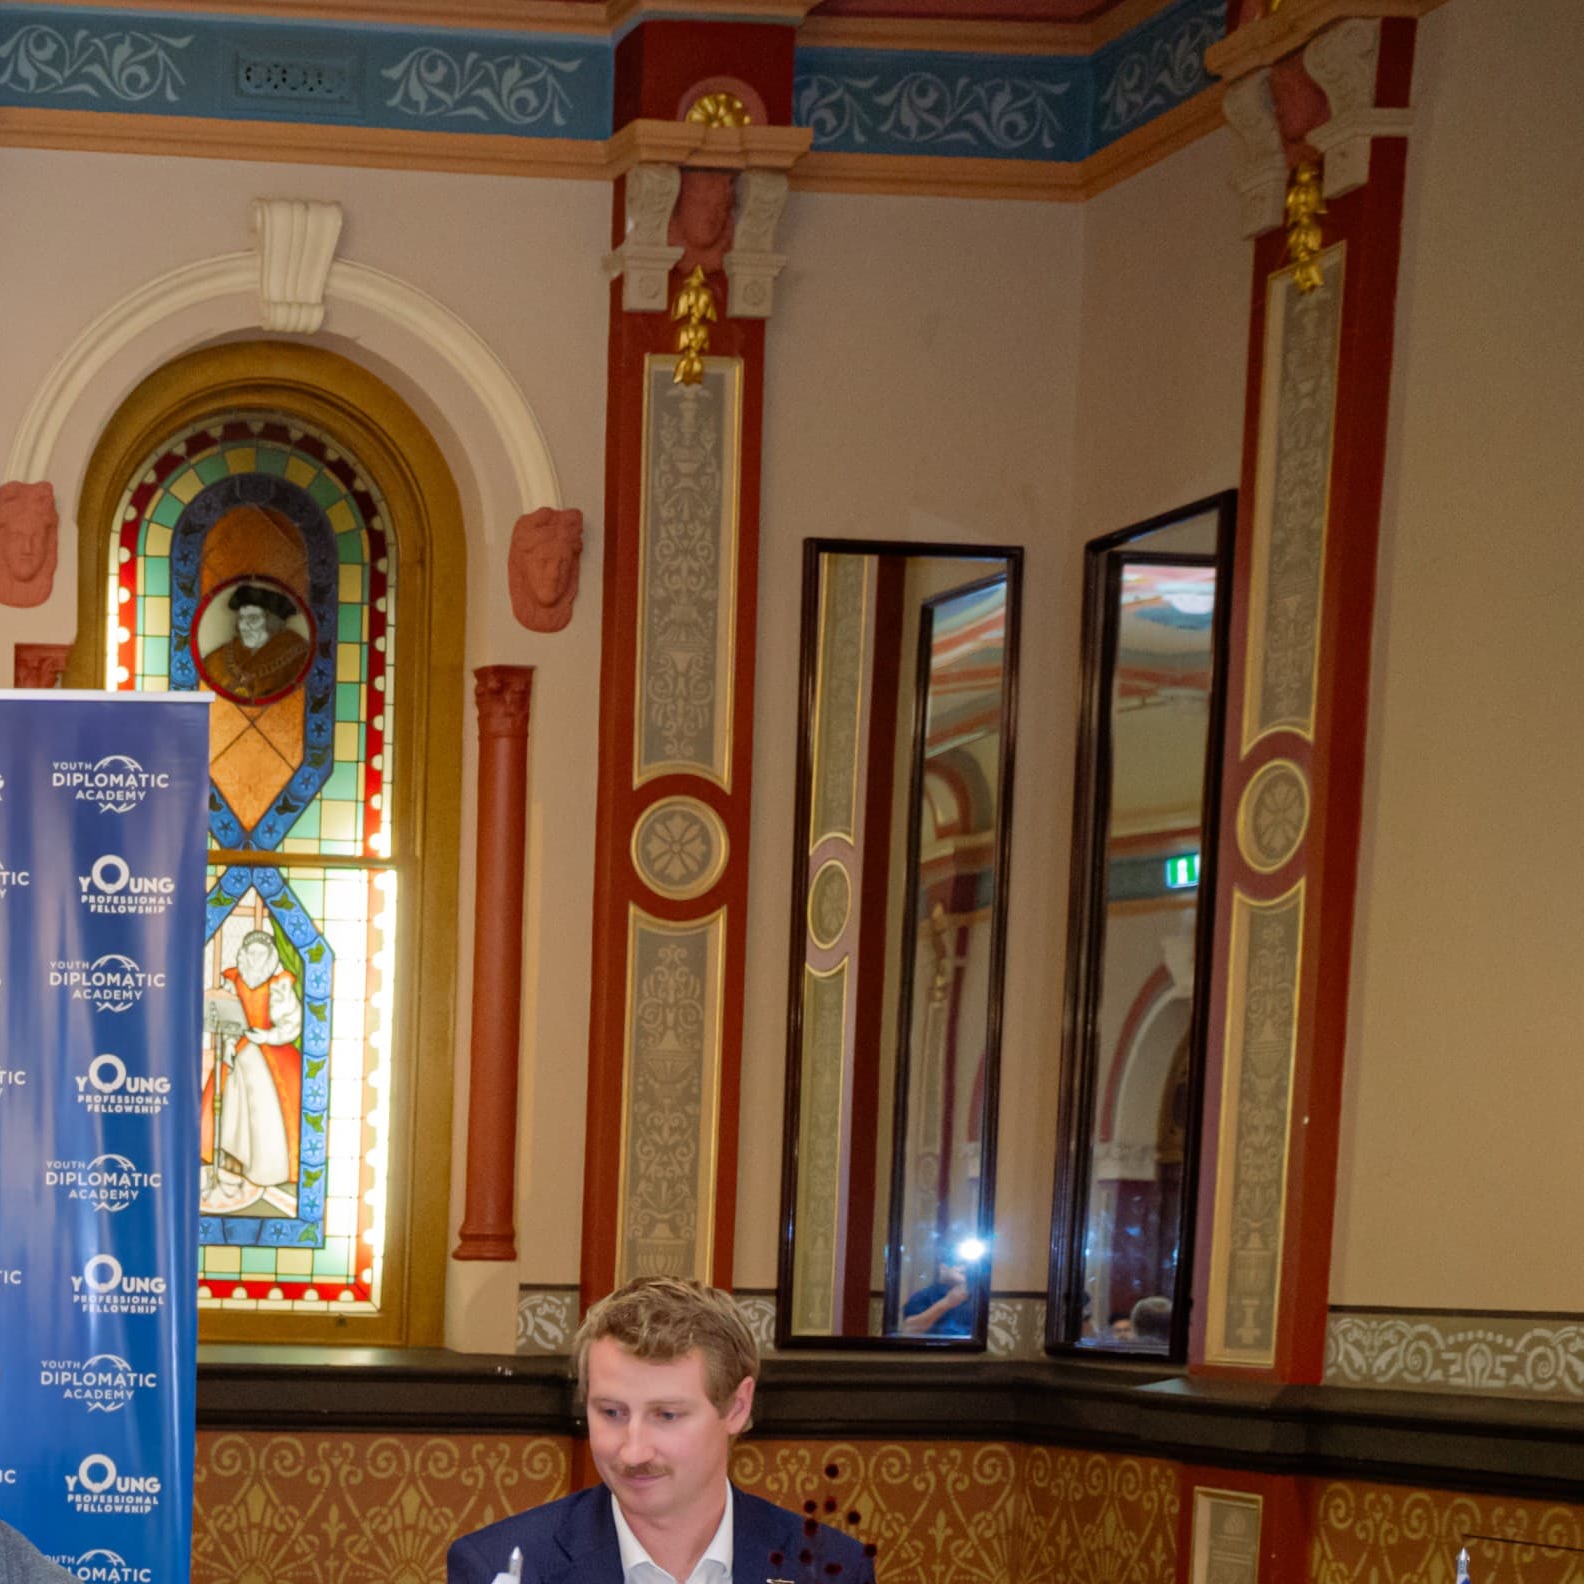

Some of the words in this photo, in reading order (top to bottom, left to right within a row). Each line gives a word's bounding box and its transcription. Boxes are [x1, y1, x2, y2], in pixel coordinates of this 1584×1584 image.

[79, 855, 173, 894] YOUNG
[81, 896, 171, 904] PROFESSIONAL
[91, 904, 165, 913] FELLOWSHIP
[41, 1362, 81, 1372] YOUTH
[41, 1372, 156, 1388] DIPLOMATIC
[64, 1388, 133, 1400] ACADEMY
[67, 1455, 161, 1494] YOUNG
[68, 1496, 158, 1504] PROFESSIONAL
[77, 1504, 152, 1513] FELLOWSHIP
